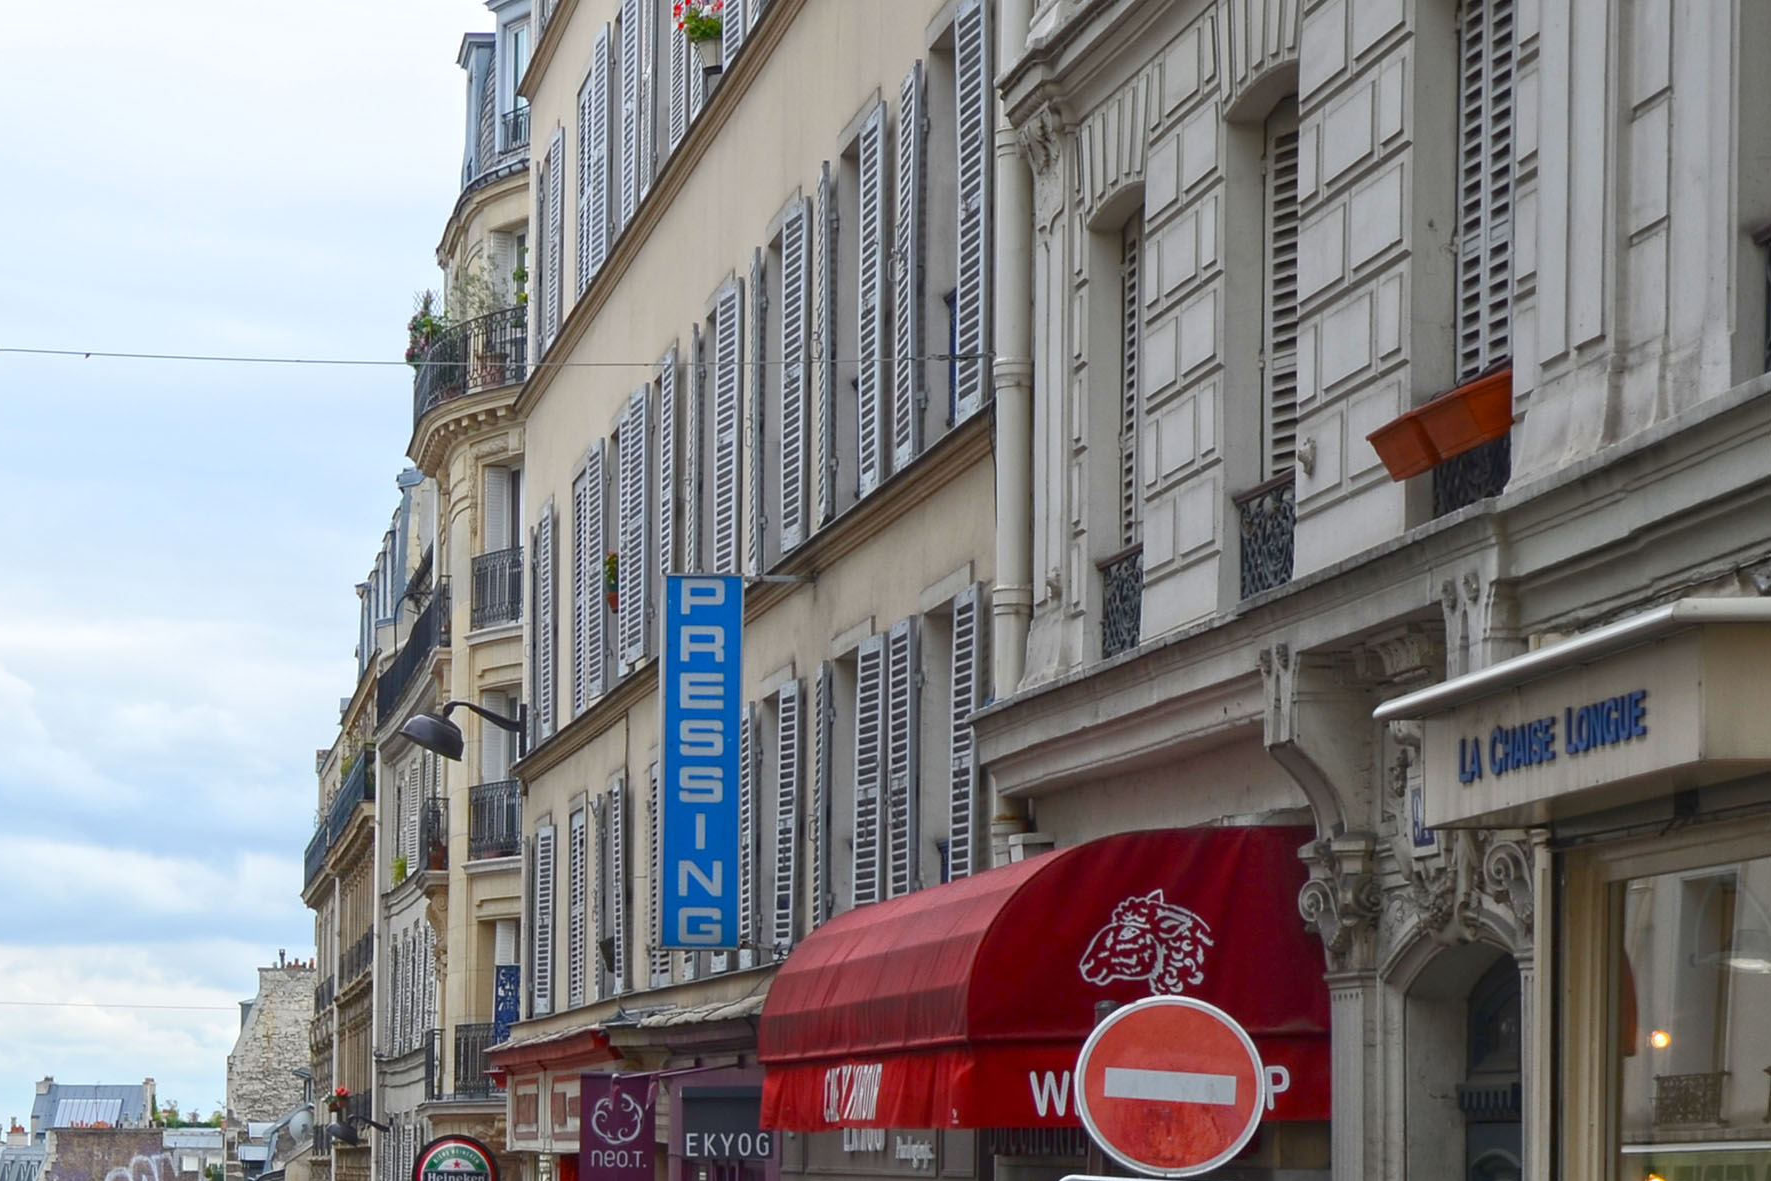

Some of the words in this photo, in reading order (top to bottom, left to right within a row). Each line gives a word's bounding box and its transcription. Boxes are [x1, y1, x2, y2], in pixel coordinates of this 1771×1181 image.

[677, 579, 726, 945] PRESSING
[1459, 737, 1483, 783] LA
[1489, 716, 1557, 777] CHAISE
[1565, 689, 1648, 755] LONGUE
[1413, 792, 1435, 840] 9
[686, 1132, 770, 1157] EKYOG
